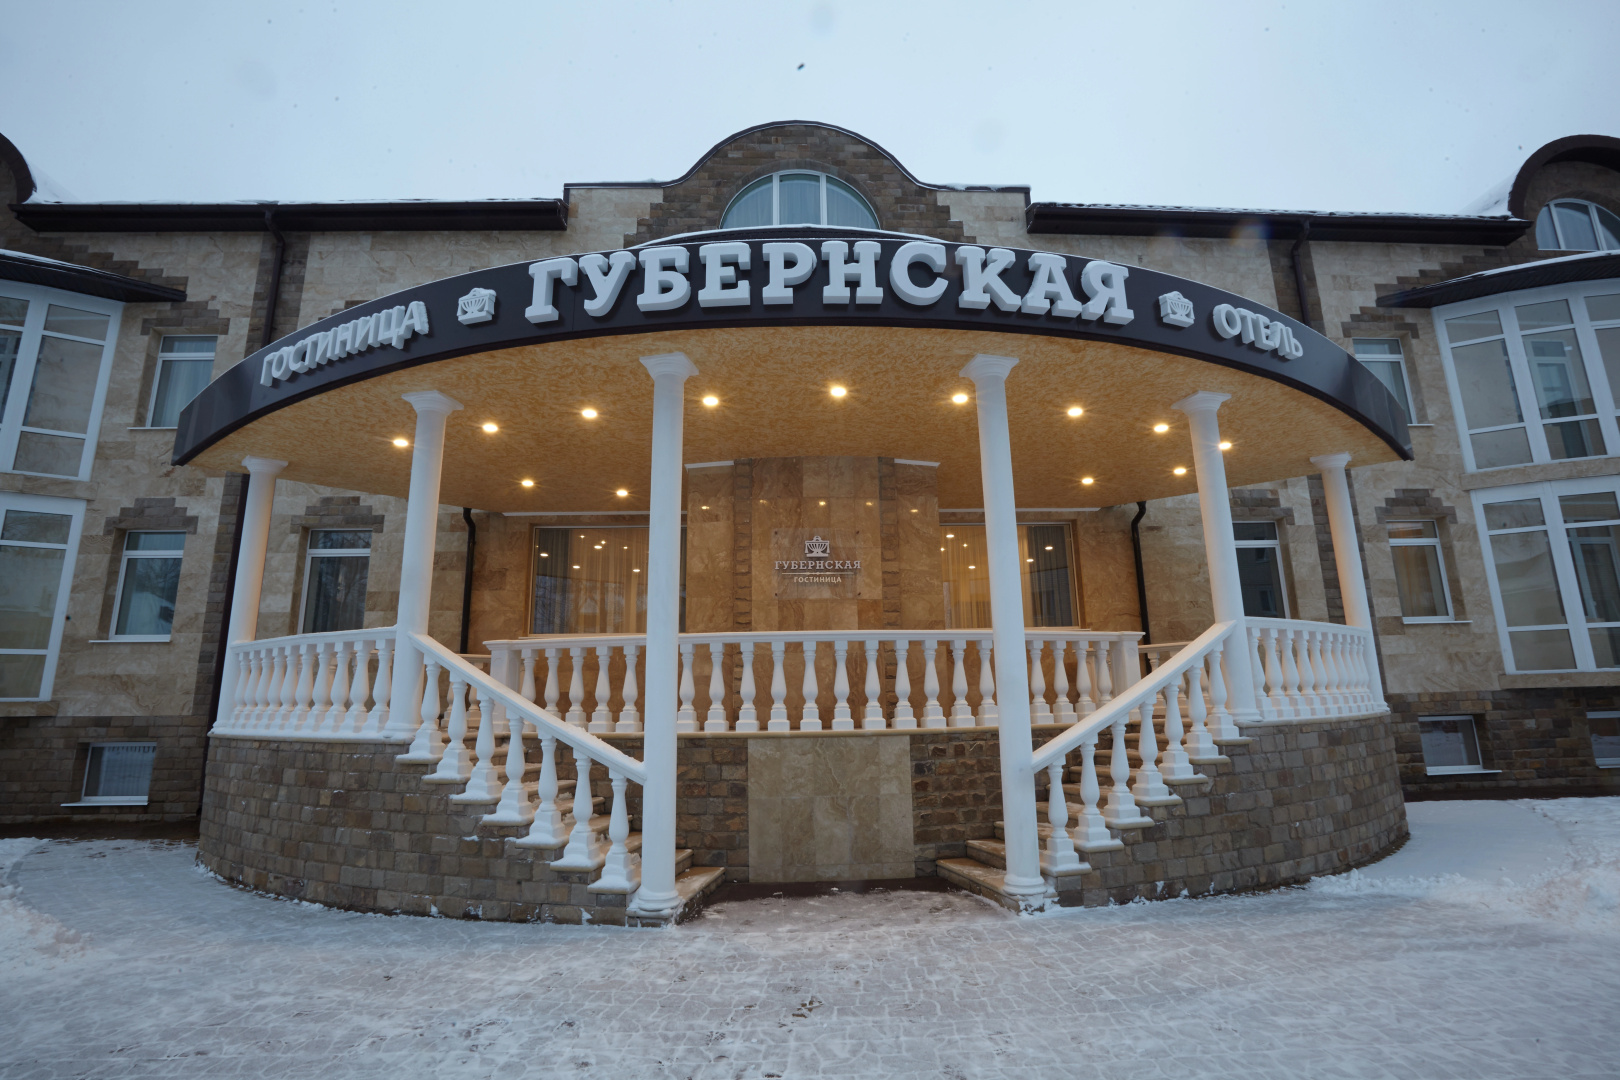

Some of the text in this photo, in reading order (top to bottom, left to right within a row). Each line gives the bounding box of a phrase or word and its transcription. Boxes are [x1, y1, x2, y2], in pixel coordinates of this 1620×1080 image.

[260, 240, 1304, 387] ГОСТИНИЦА ГУБЕРНСКАЯ ОТЕЛЬ
[775, 560, 861, 570] ГУБЕРНСКАЯ
